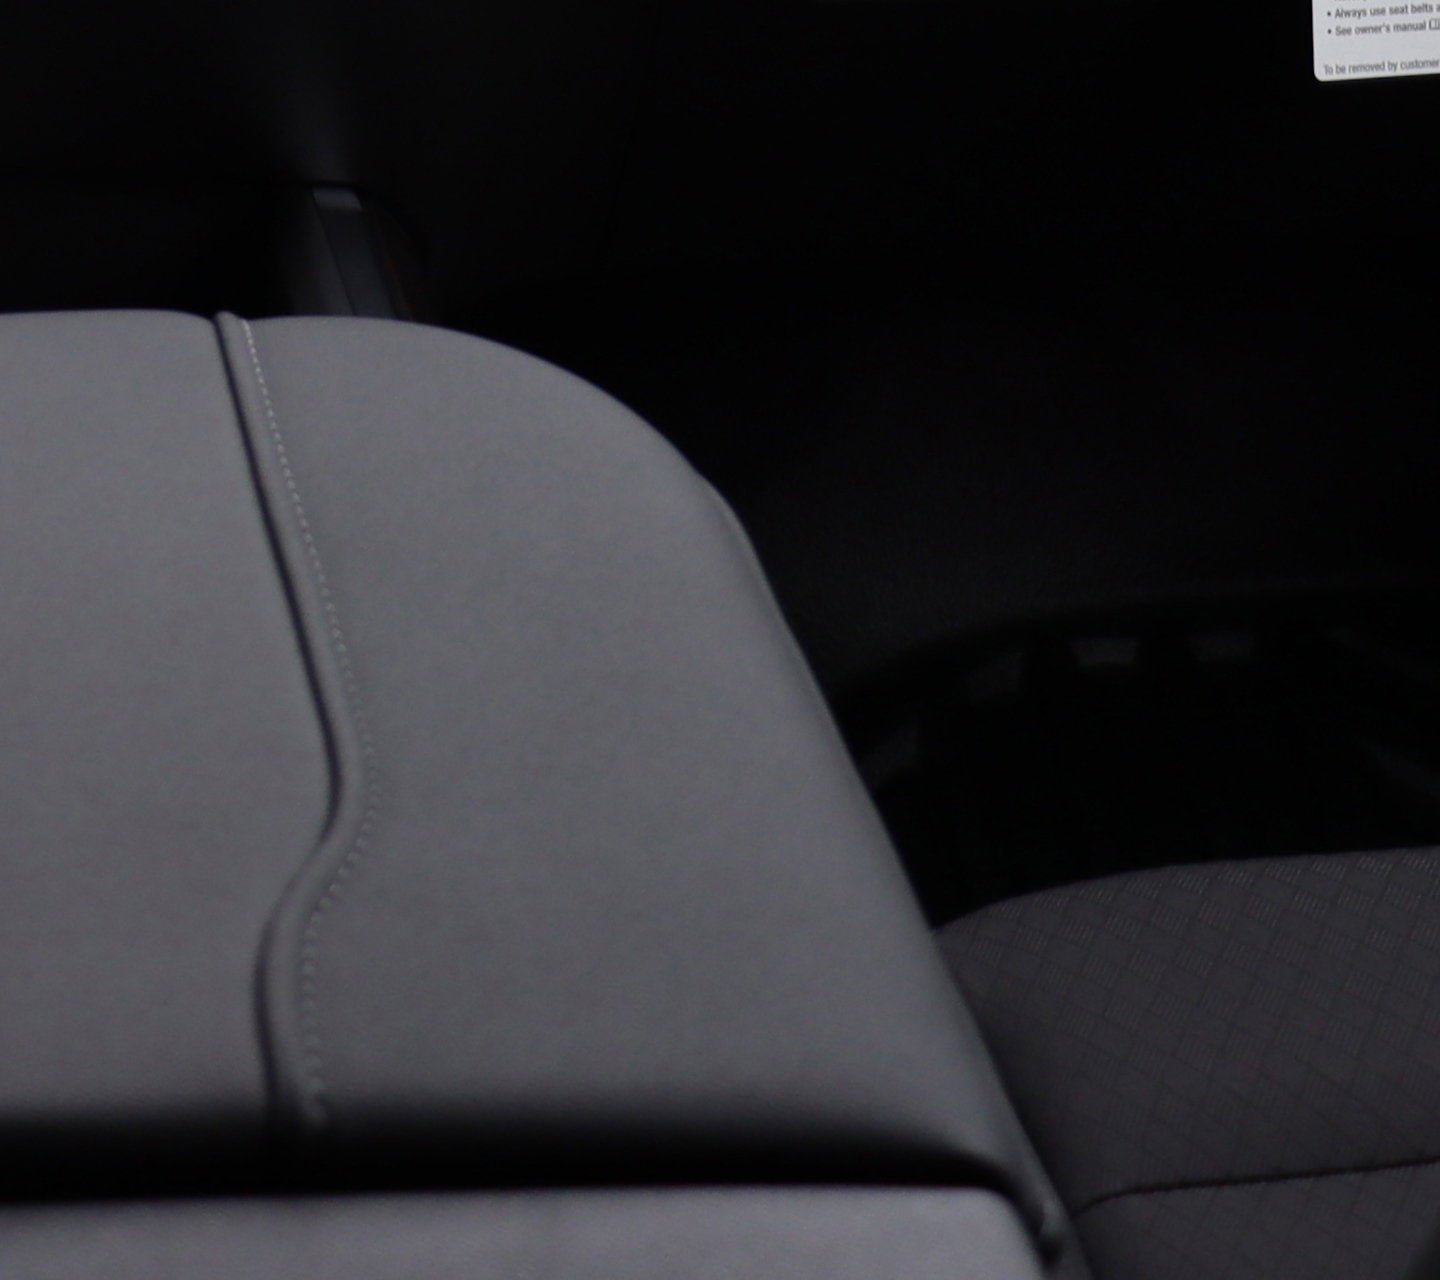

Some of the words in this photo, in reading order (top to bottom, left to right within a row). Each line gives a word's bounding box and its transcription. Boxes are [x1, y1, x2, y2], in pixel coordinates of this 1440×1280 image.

[1335, 8, 1367, 19] Always
[1369, 7, 1386, 16] use
[1389, 5, 1409, 15] seat
[1411, 3, 1434, 14] belts
[1335, 26, 1352, 36] See
[1355, 23, 1391, 35] owner's
[1393, 21, 1427, 32] manual
[1323, 64, 1334, 75] To
[1335, 63, 1347, 74] be
[1348, 61, 1385, 73] removed
[1387, 60, 1398, 72] by
[1400, 58, 1440, 70] customer
